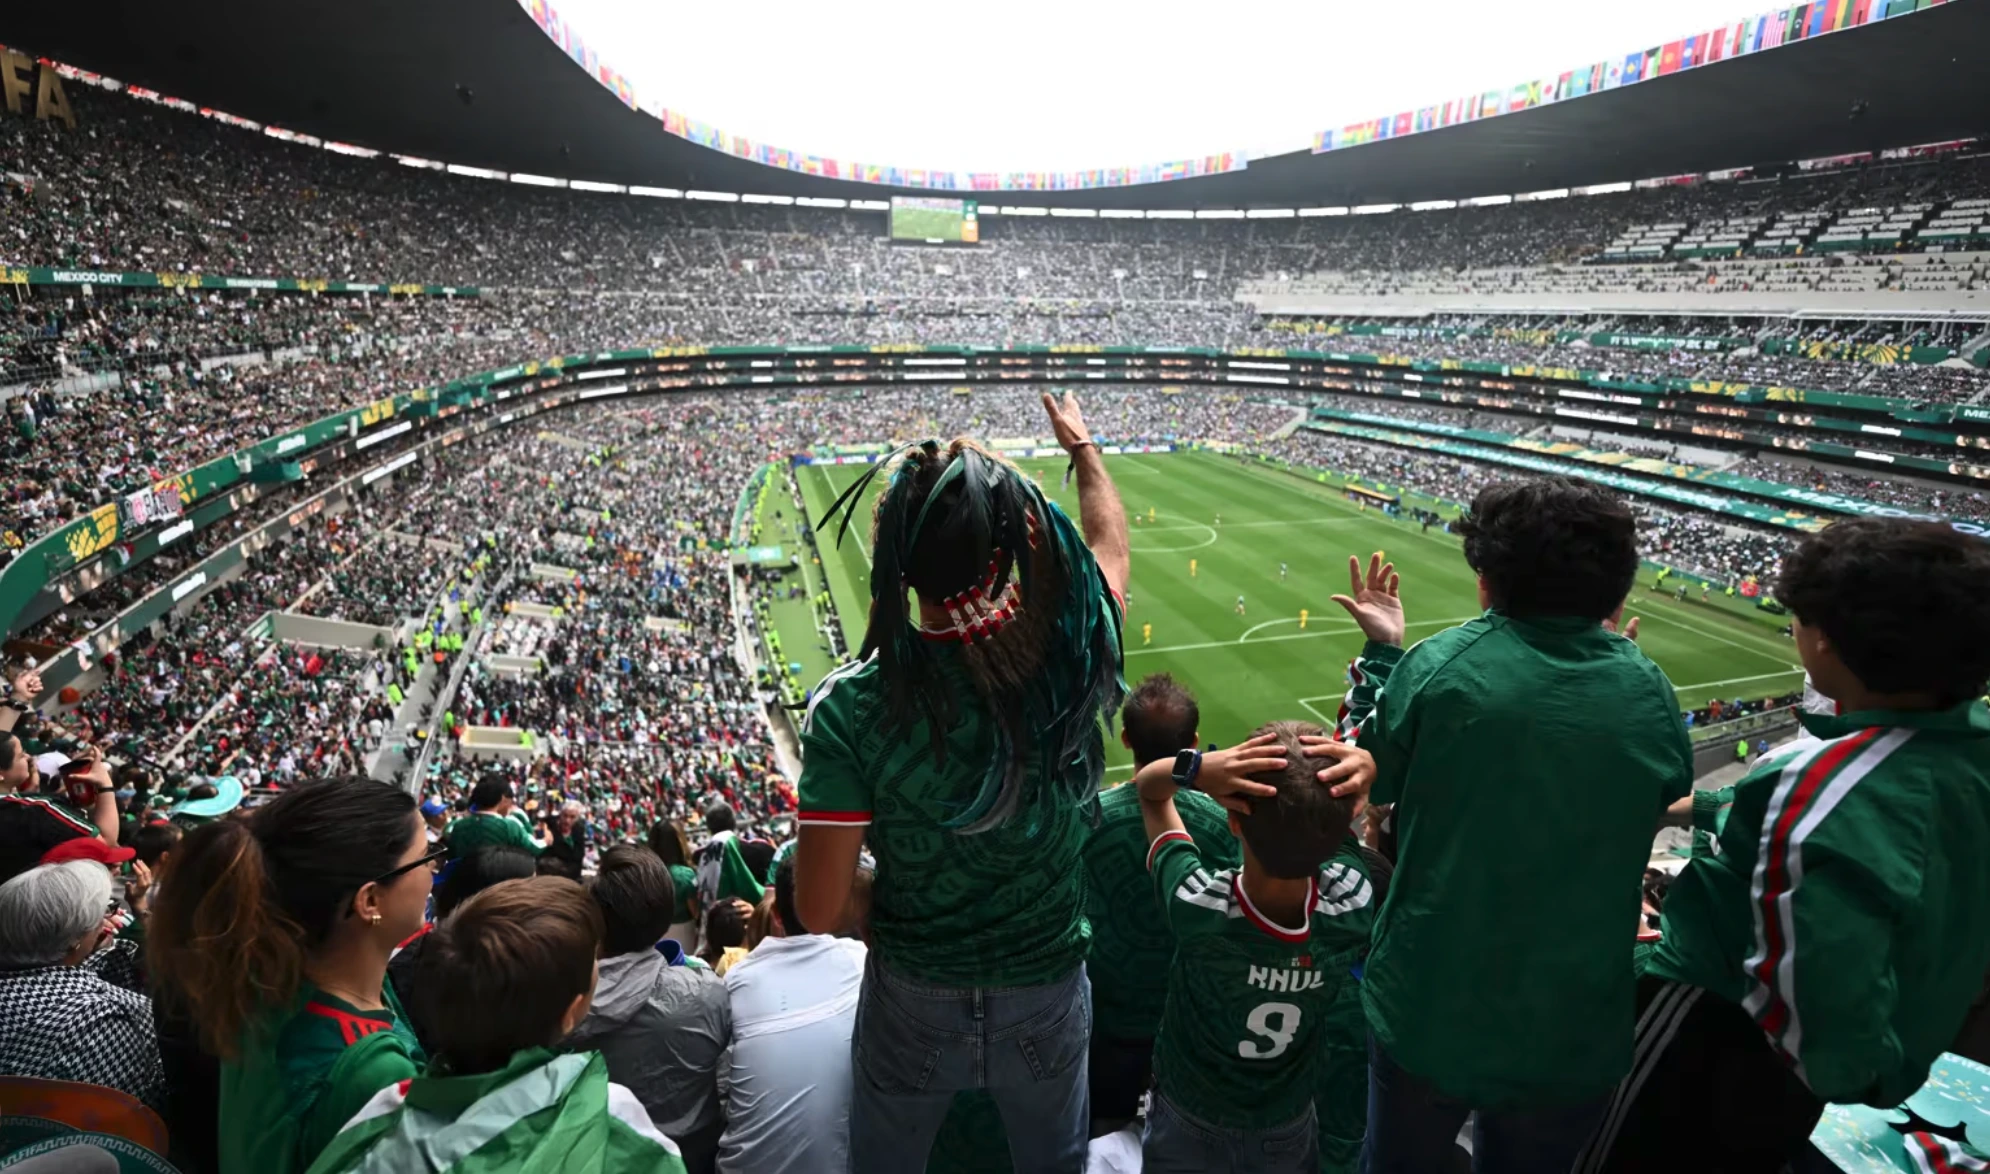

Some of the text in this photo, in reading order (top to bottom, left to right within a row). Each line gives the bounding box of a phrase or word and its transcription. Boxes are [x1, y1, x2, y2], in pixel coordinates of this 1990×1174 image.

[53, 271, 123, 283] MEXICO CITY
[1963, 408, 1990, 420] ME
[1238, 1001, 1302, 1059] 9
[19, 1143, 44, 1160] FIFA
[141, 1153, 165, 1172] FIFA
